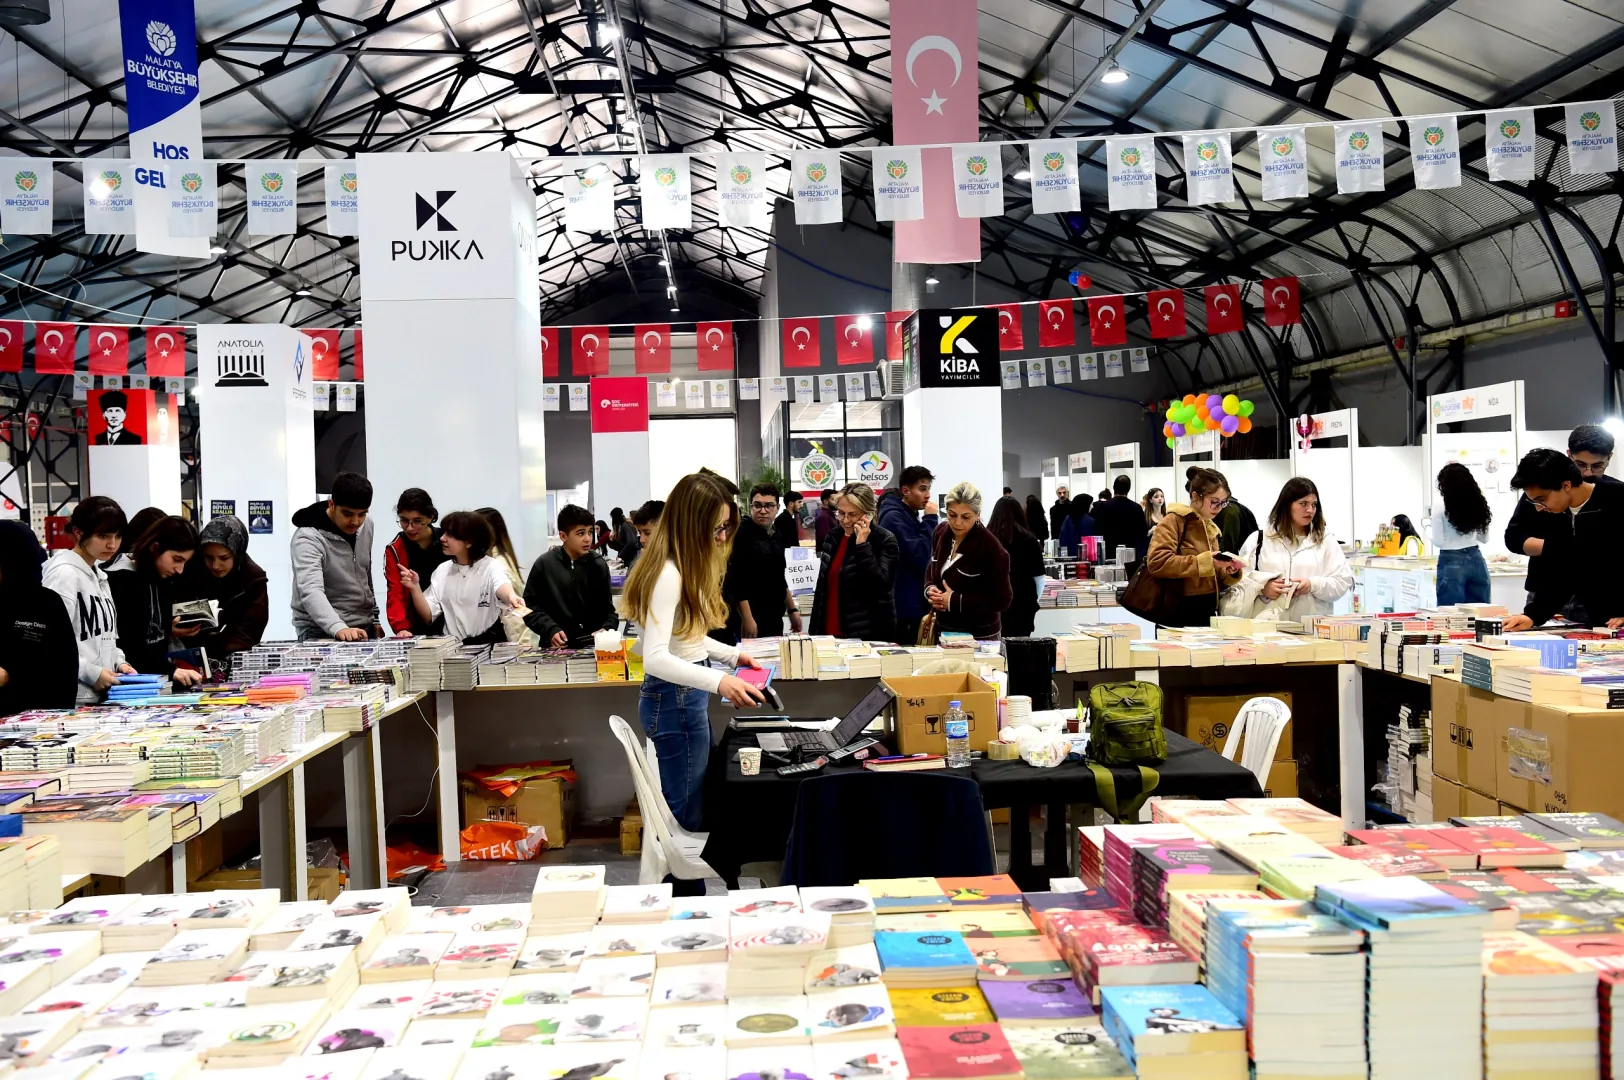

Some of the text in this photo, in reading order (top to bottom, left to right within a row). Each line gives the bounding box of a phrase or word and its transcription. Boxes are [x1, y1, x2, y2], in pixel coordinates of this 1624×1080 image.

[145, 54, 182, 70] MALATYA
[127, 59, 198, 88] BÜYÜKŞEHİR
[147, 80, 186, 95] BELEDİYESİ
[217, 340, 264, 348] ANATOLIA
[940, 356, 980, 373] KİBA
[861, 473, 889, 482] belsos
